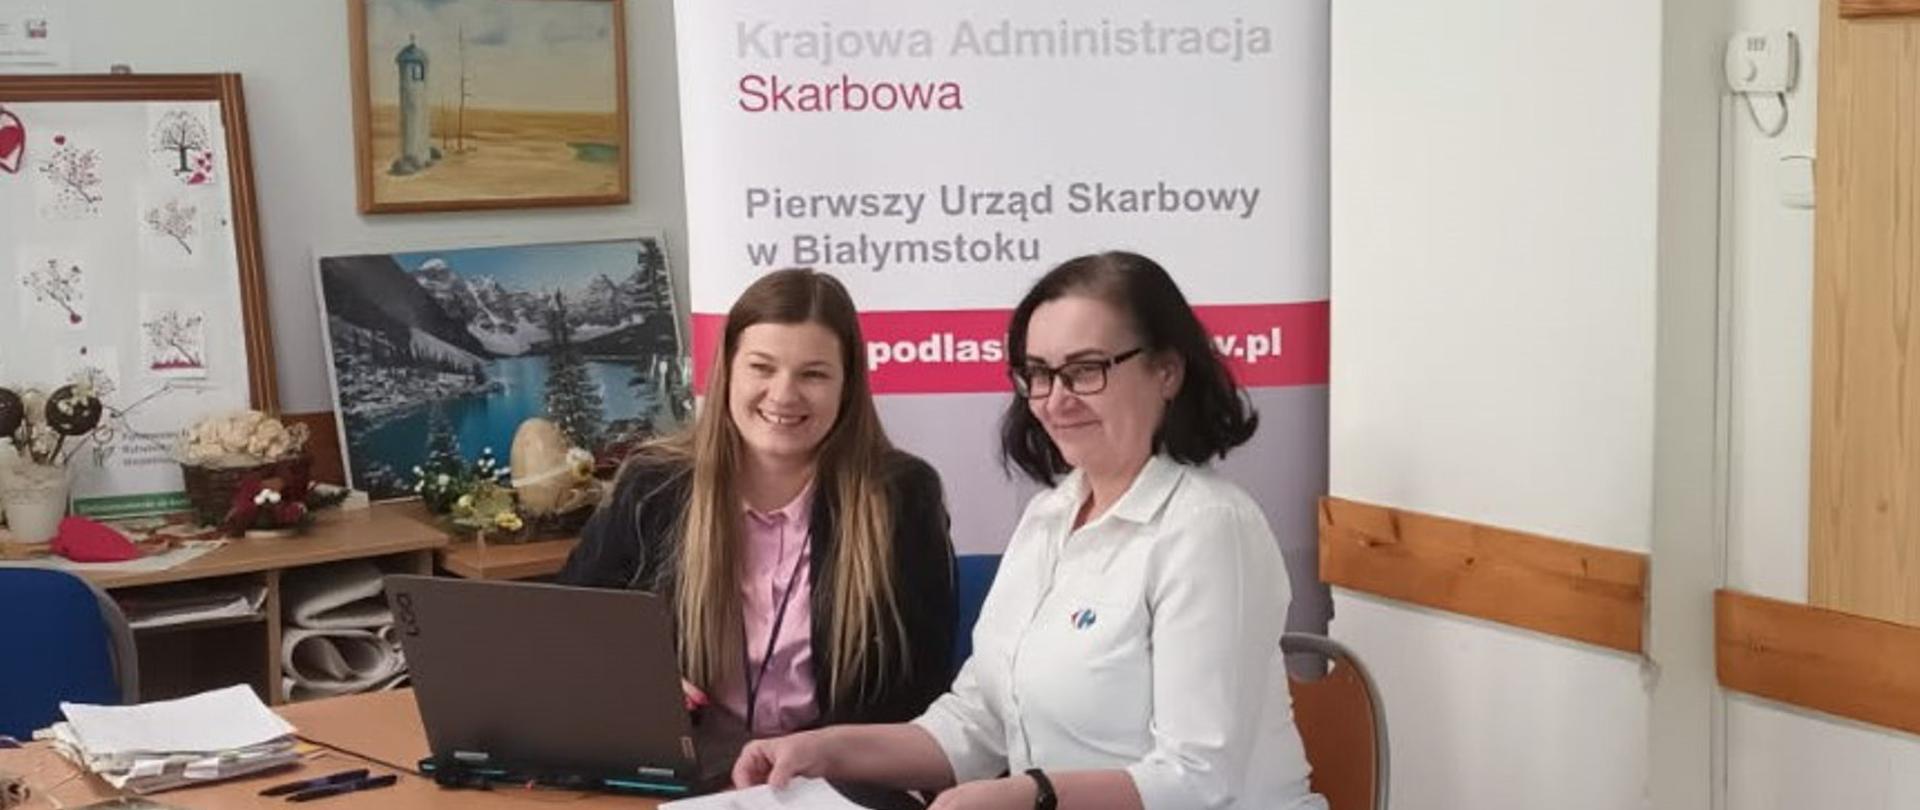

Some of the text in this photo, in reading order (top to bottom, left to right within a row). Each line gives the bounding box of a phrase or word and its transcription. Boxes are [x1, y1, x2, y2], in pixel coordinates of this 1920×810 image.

[737, 18, 1273, 65] Krajowa Administracja
[738, 74, 964, 112] Skarbowa
[746, 182, 1260, 225] Pierwszy Urząd Skarbowy
[747, 232, 1040, 271] w Białymstoku
[866, 326, 1282, 371] podlas v.pl
